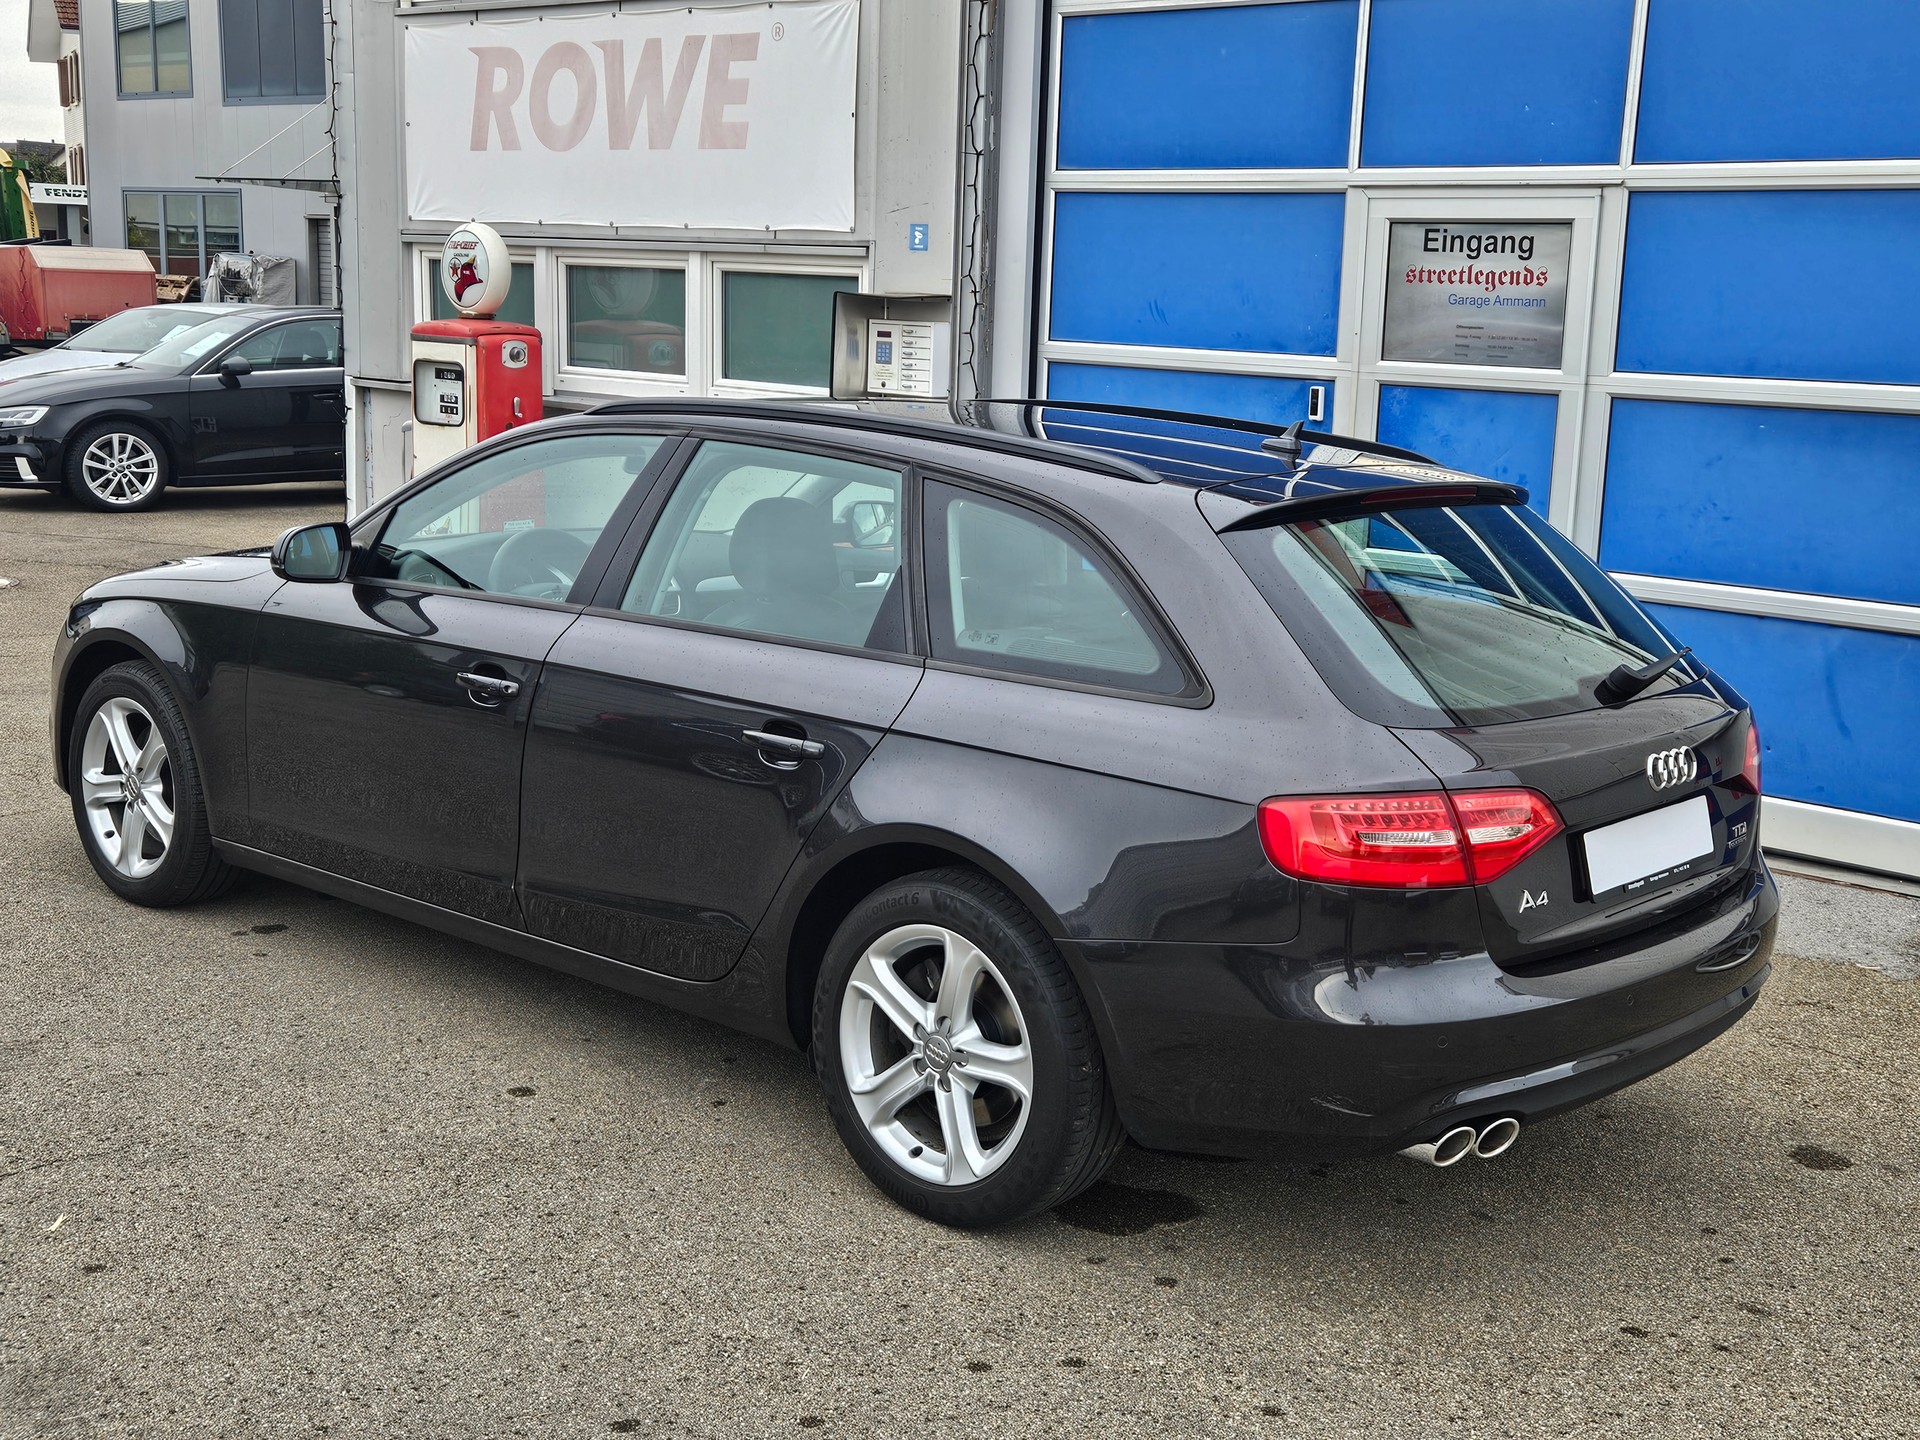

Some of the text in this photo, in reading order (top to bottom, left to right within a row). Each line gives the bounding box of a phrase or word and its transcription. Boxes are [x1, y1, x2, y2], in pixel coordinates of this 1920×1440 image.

[467, 31, 760, 152] ROWE
[1423, 228, 1535, 261] Eingang
[1405, 263, 1549, 292] streetlegends
[1448, 293, 1546, 308] Garage Ammann
[911, 892, 920, 905] 6
[1518, 889, 1549, 914] A4
